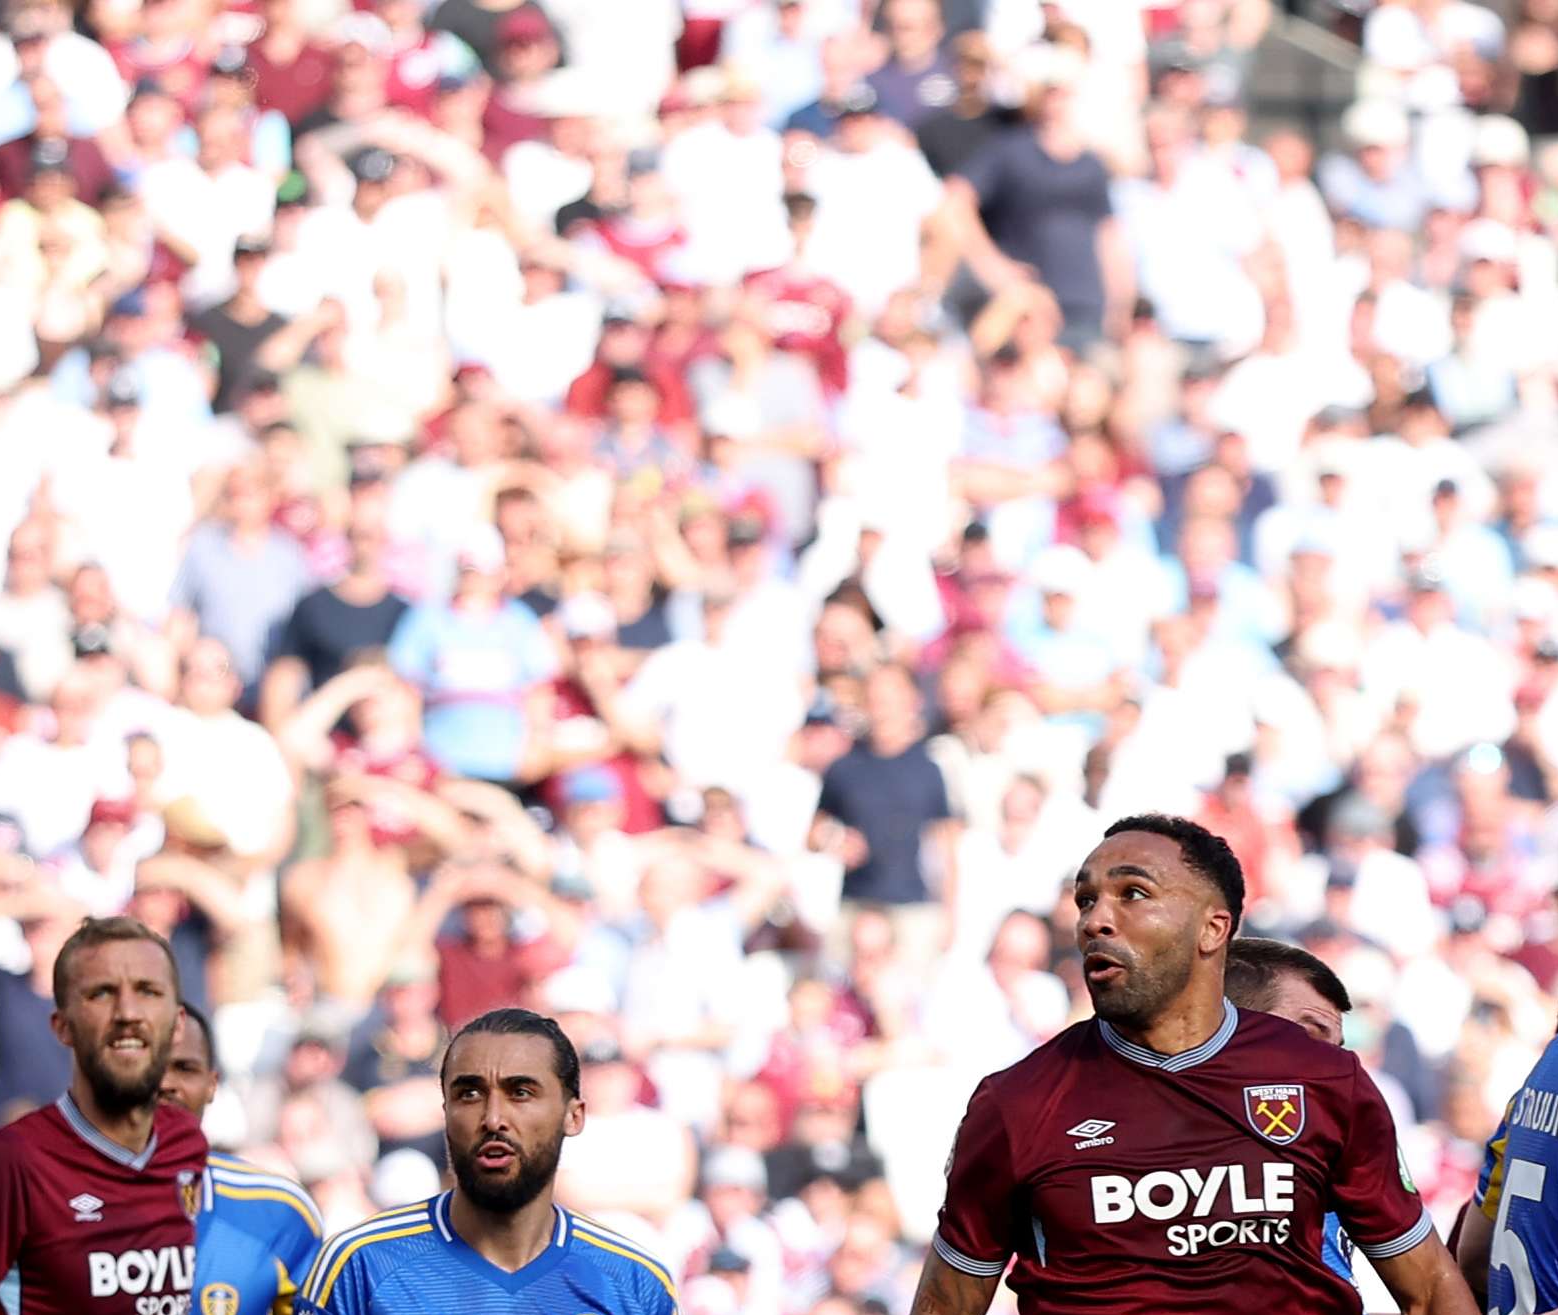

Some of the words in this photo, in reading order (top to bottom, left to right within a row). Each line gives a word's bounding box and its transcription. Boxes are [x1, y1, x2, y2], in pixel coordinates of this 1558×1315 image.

[1074, 1136, 1115, 1150] umbro
[1090, 1162, 1295, 1224] BOYLE
[1166, 1218, 1292, 1257] SPORTS
